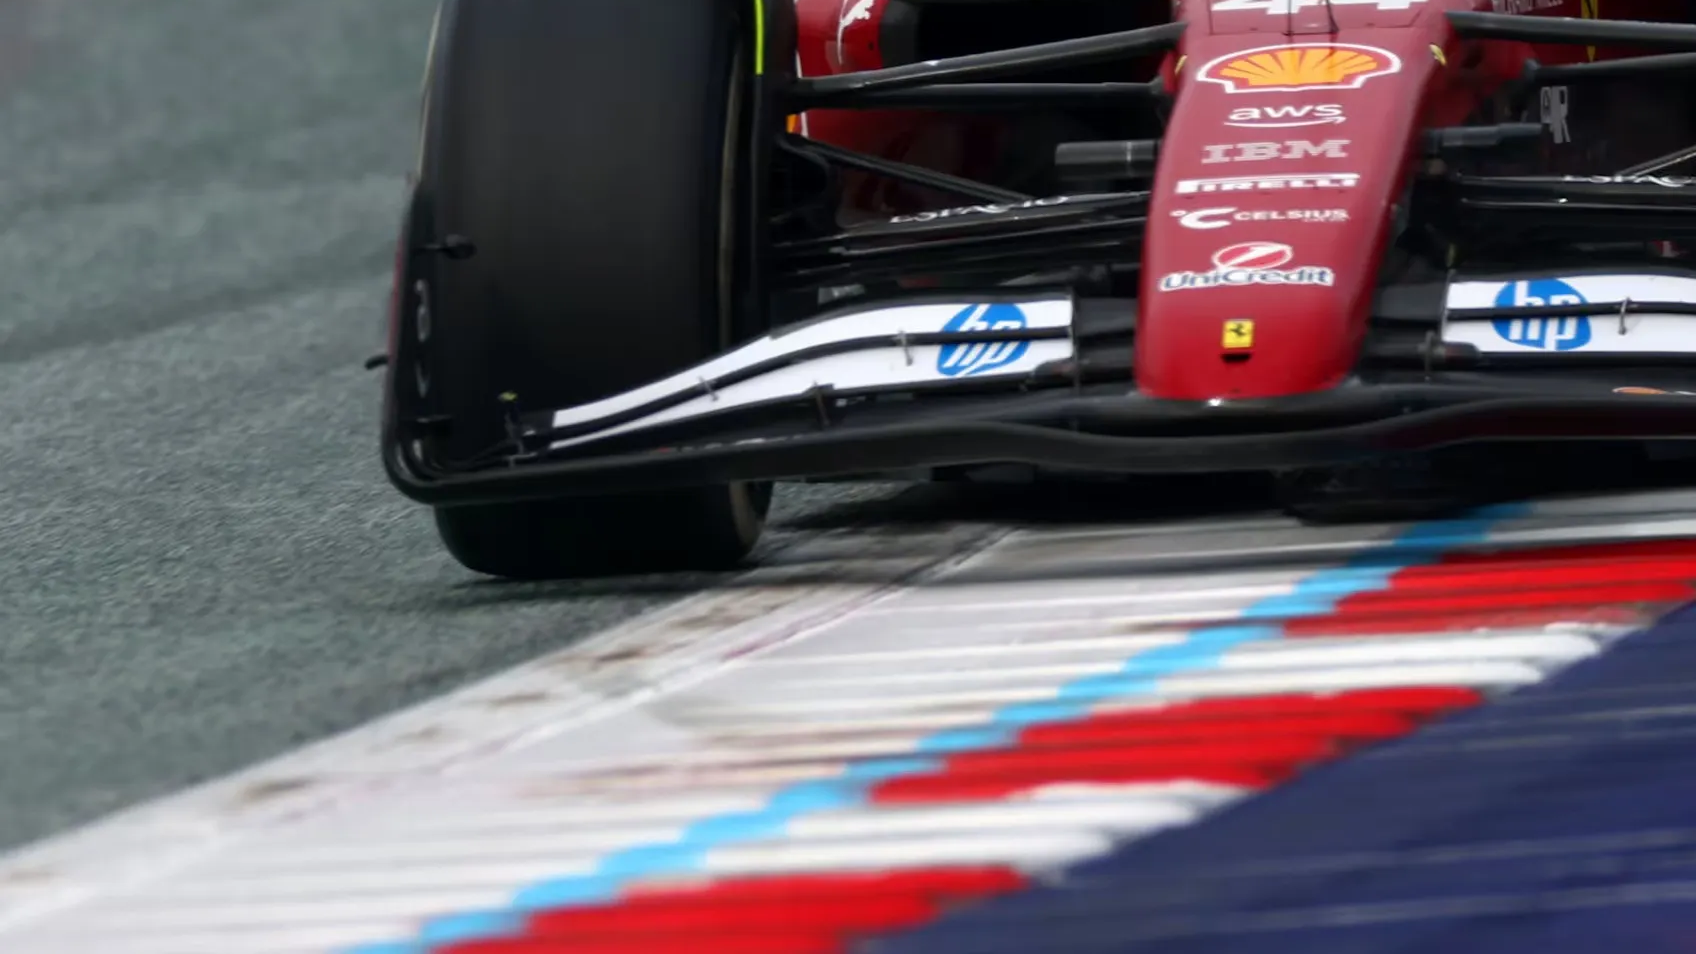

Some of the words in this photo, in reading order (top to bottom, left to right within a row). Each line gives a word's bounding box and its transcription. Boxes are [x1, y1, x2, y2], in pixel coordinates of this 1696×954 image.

[1228, 104, 1344, 122] aws
[1202, 140, 1352, 164] IBM
[1176, 173, 1361, 194] PIRELLI
[1163, 268, 1330, 290] UniCredit
[1508, 280, 1582, 351] hp
[942, 304, 1026, 376] hp
